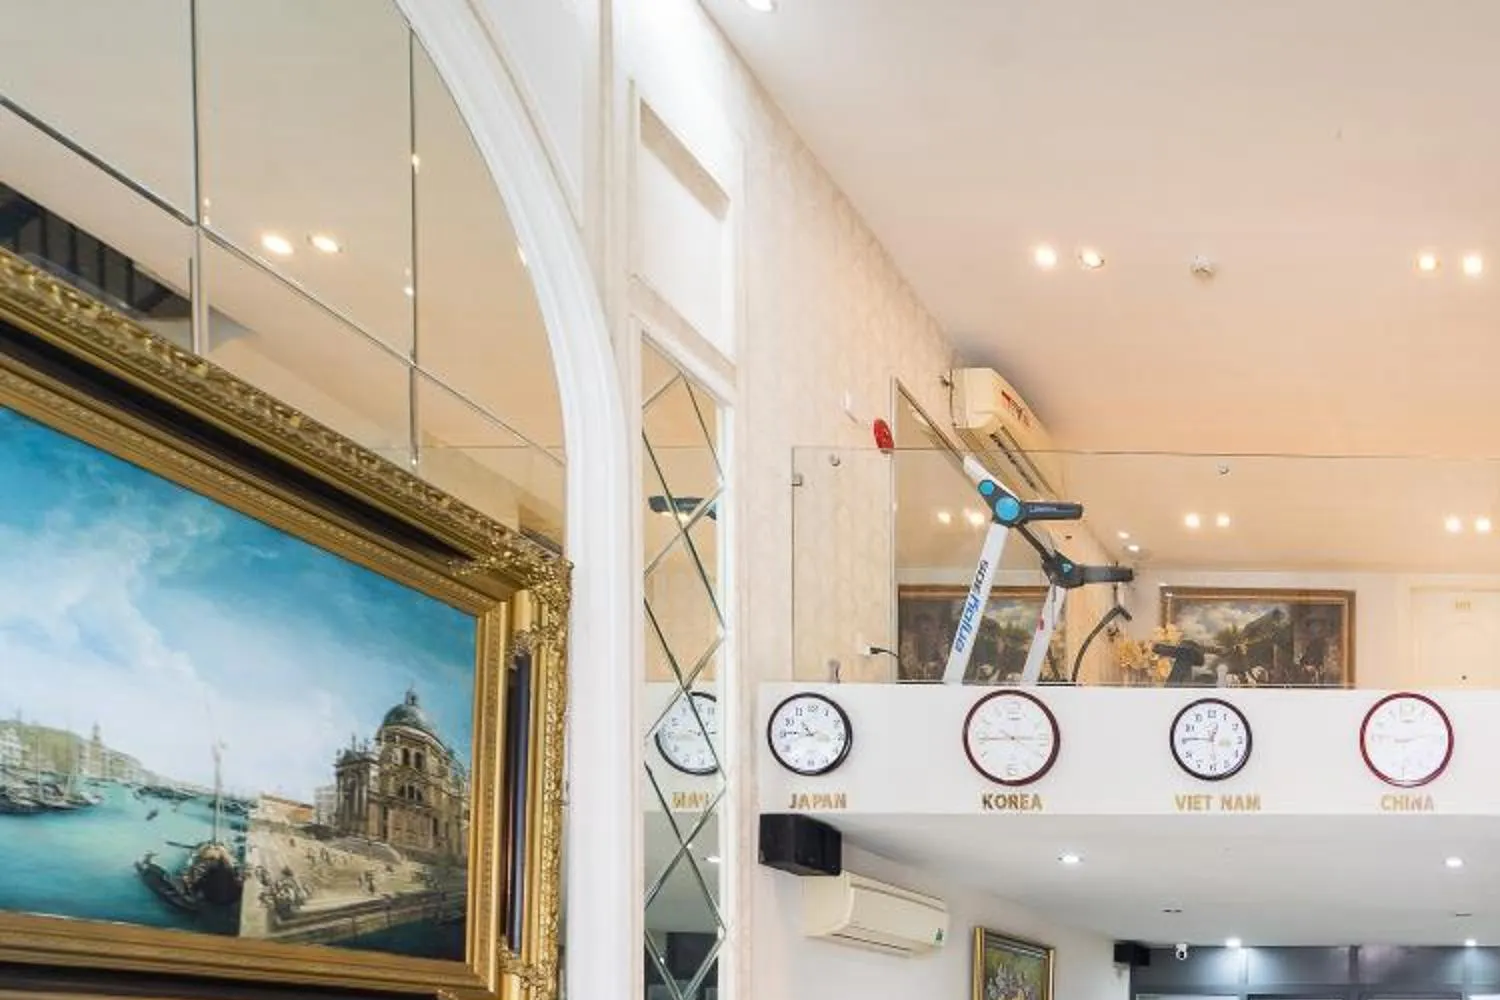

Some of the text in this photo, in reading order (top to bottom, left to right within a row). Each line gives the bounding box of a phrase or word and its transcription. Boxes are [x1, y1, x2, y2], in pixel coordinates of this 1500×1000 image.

[788, 793, 847, 809] JAPAN
[981, 793, 1043, 810] KOREA
[1175, 795, 1261, 811] VIET NAM
[1380, 795, 1435, 811] CHINA
